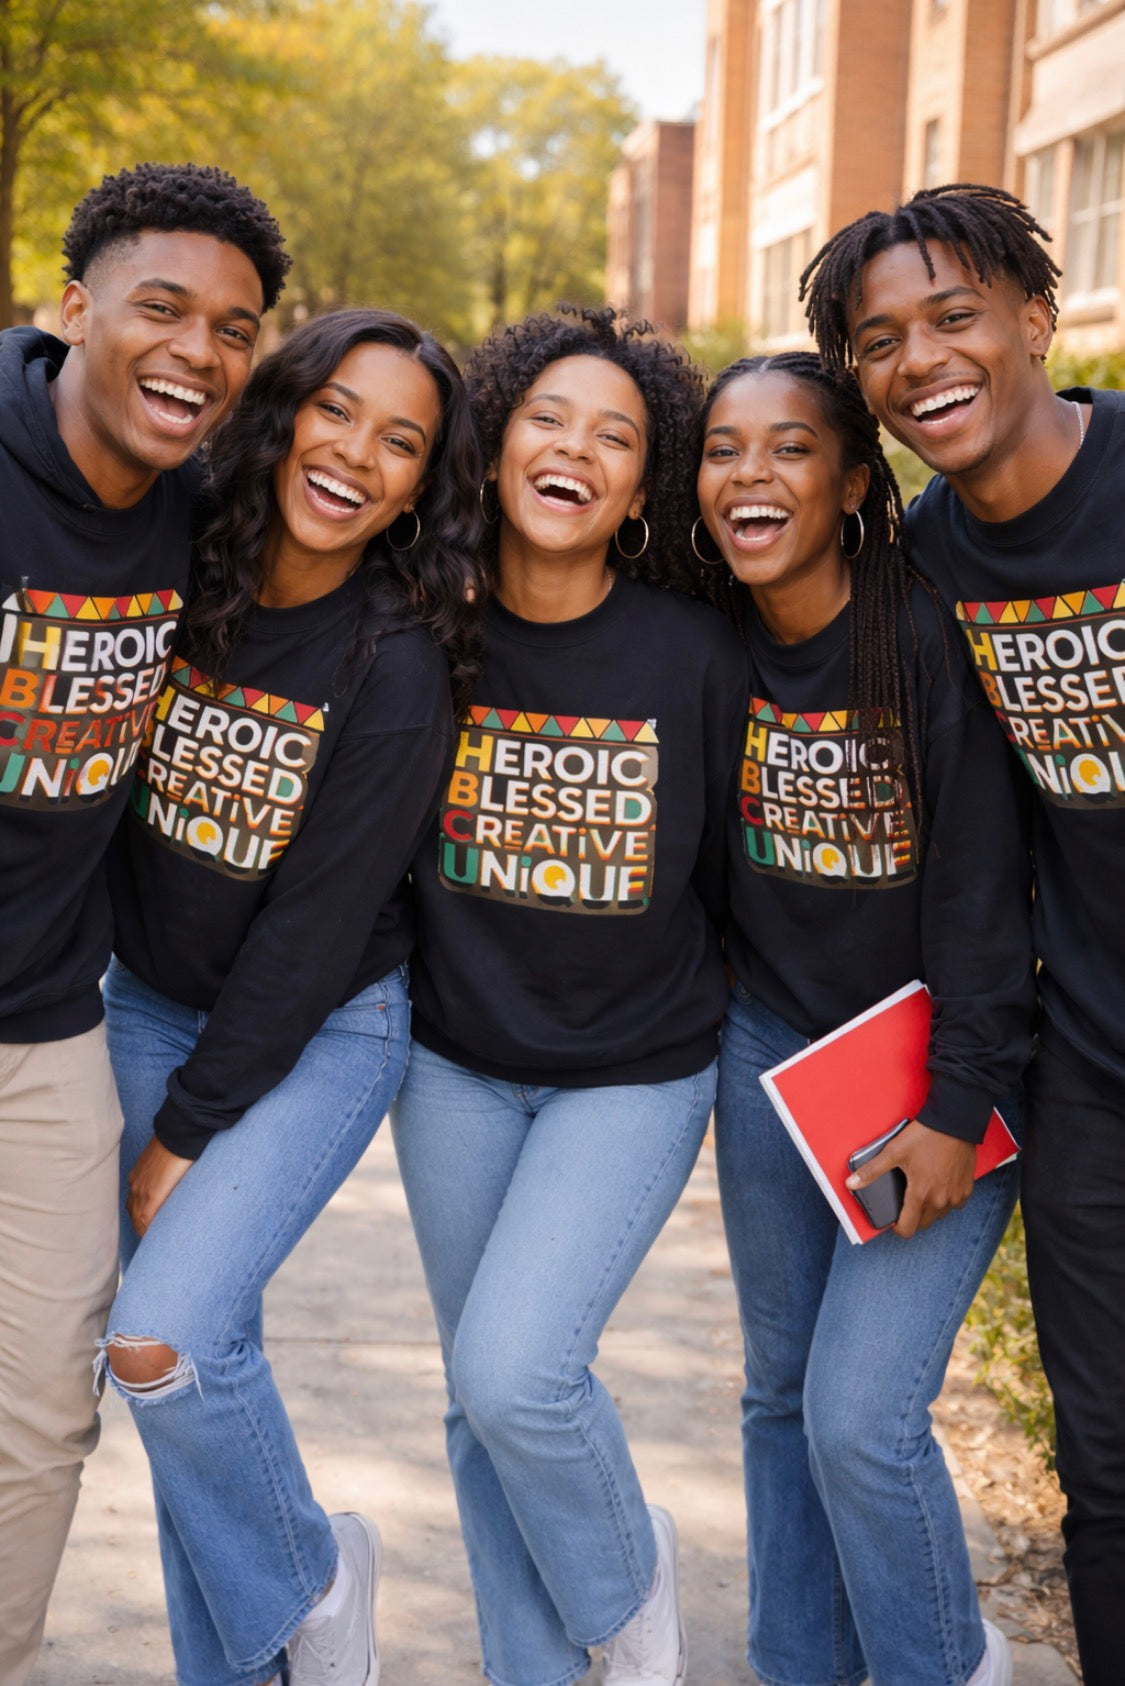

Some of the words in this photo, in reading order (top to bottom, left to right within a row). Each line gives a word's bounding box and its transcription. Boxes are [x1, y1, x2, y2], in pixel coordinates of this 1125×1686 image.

[18, 621, 177, 672] HEROIC
[455, 731, 650, 787] HEROIC
[741, 759, 902, 810] BLESSED
[448, 770, 652, 826] BLESSED
